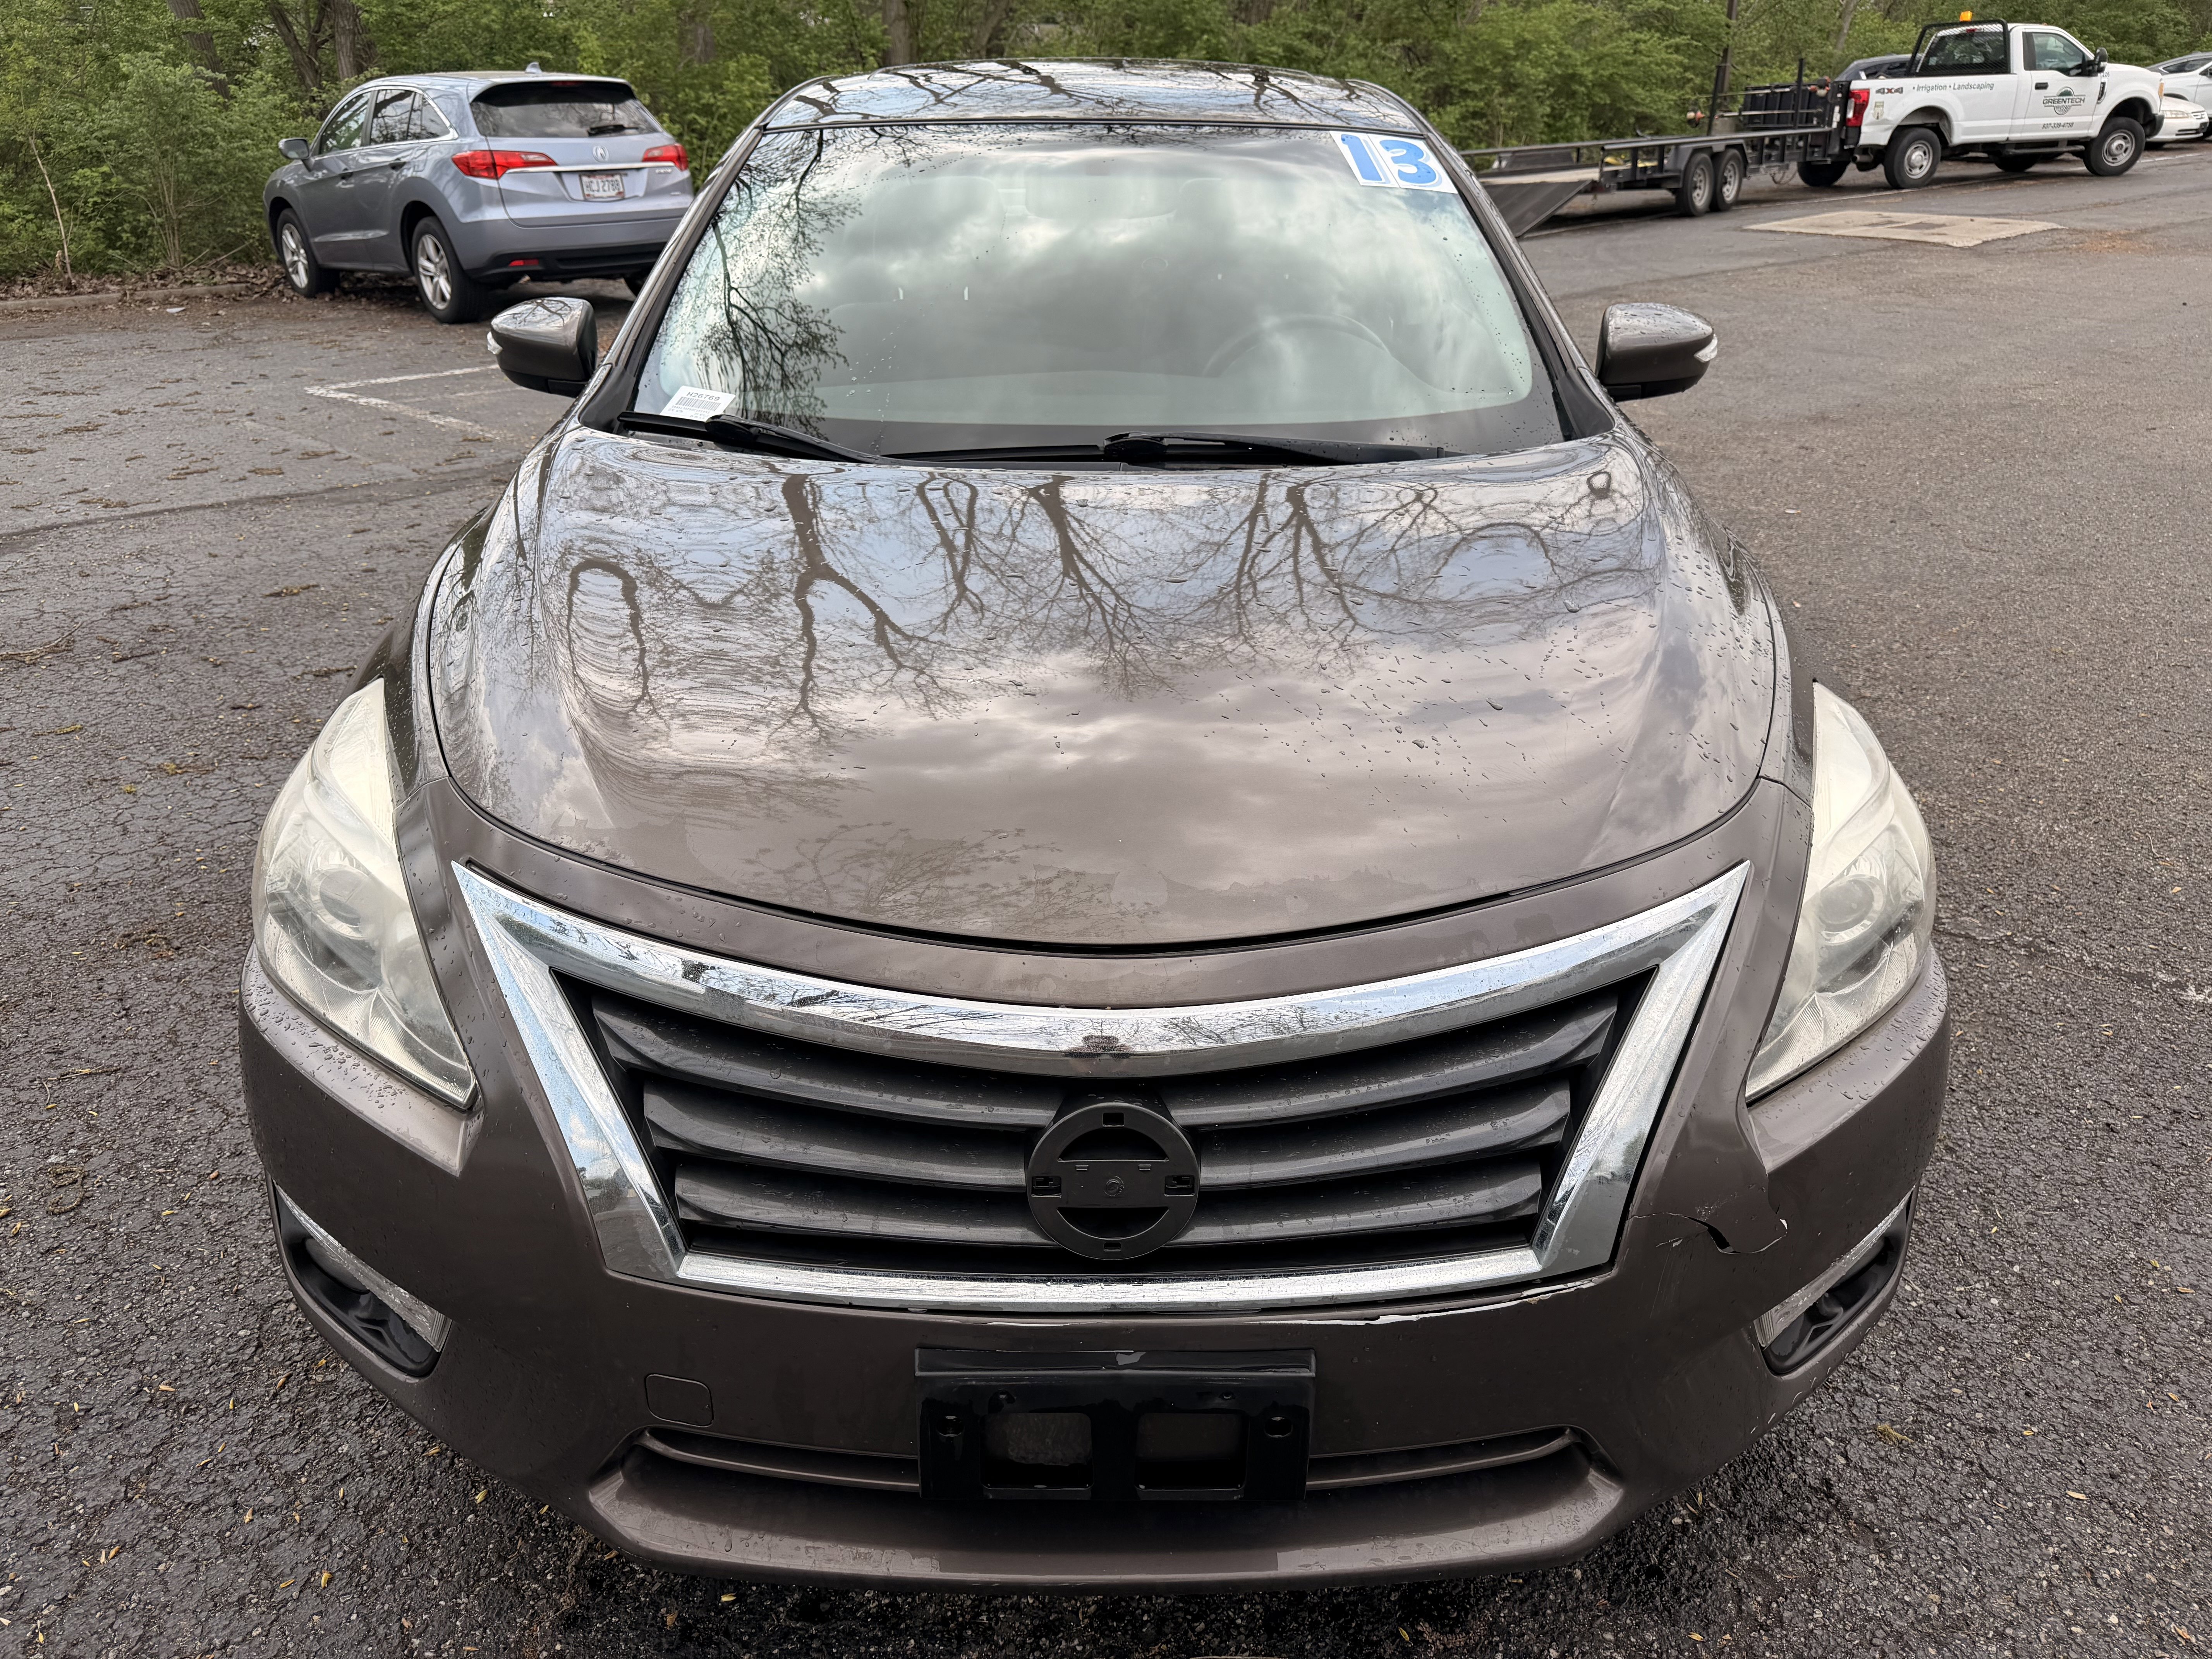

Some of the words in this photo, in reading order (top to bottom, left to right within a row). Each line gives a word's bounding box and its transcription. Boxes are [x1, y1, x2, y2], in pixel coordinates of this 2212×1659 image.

[1917, 83, 1947, 93] Irrigation
[1953, 82, 1994, 91] Landscaping
[1341, 134, 1437, 184] 13
[686, 392, 720, 401] H26769
